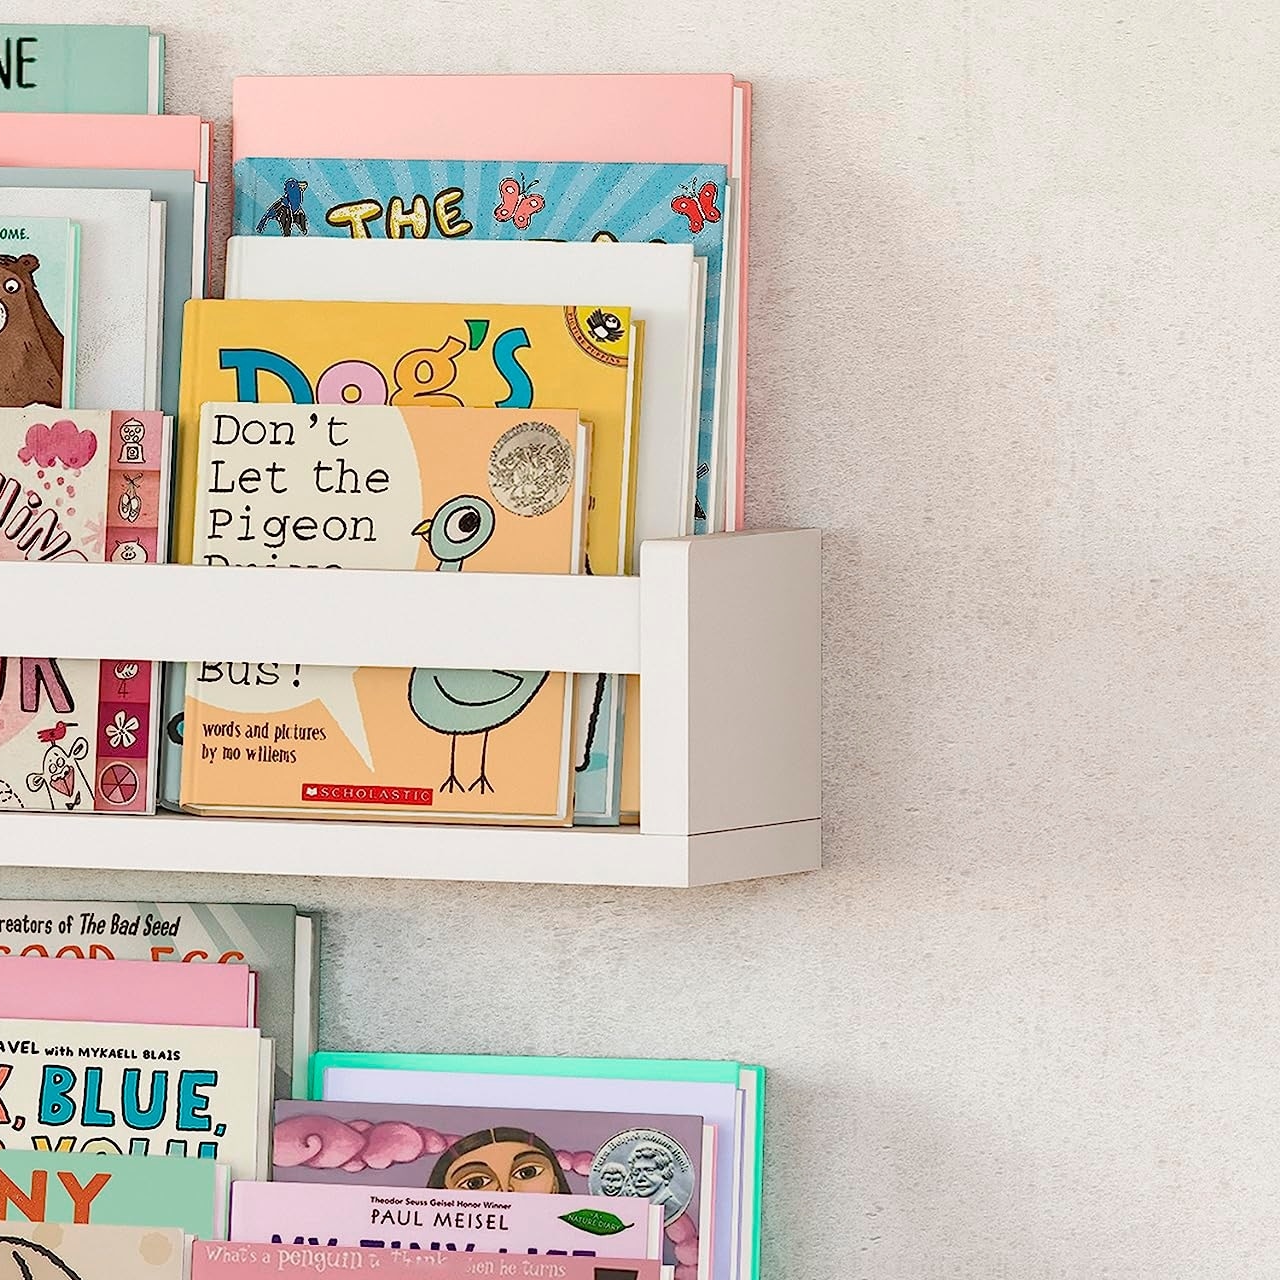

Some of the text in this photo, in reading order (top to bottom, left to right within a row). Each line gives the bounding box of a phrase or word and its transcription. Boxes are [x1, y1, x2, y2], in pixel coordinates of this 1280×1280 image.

[326, 187, 472, 239] THE
[211, 413, 350, 447] Don't
[208, 459, 390, 494] Let the
[207, 505, 377, 549] Pigeon
[202, 722, 327, 743] words and pictures
[201, 744, 297, 764] by mo willems
[320, 788, 431, 802] SCHOLASTIC
[58, 915, 74, 934] of
[80, 912, 106, 936] The
[110, 914, 140, 936] Bad
[143, 913, 182, 937] Seed
[44, 1046, 74, 1057] with
[78, 1048, 138, 1060] MYKAELL
[142, 1050, 181, 1061] BLAIS
[38, 1063, 226, 1138] BLUE,
[370, 1196, 512, 1210] Theodor Seuss Geisel Honor Winner
[370, 1208, 509, 1231] PAUL MEISEL
[205, 1244, 257, 1264] What's
[262, 1252, 270, 1264] a
[278, 1248, 363, 1273] penguin
[500, 1259, 517, 1277] he
[522, 1260, 567, 1278] turns
